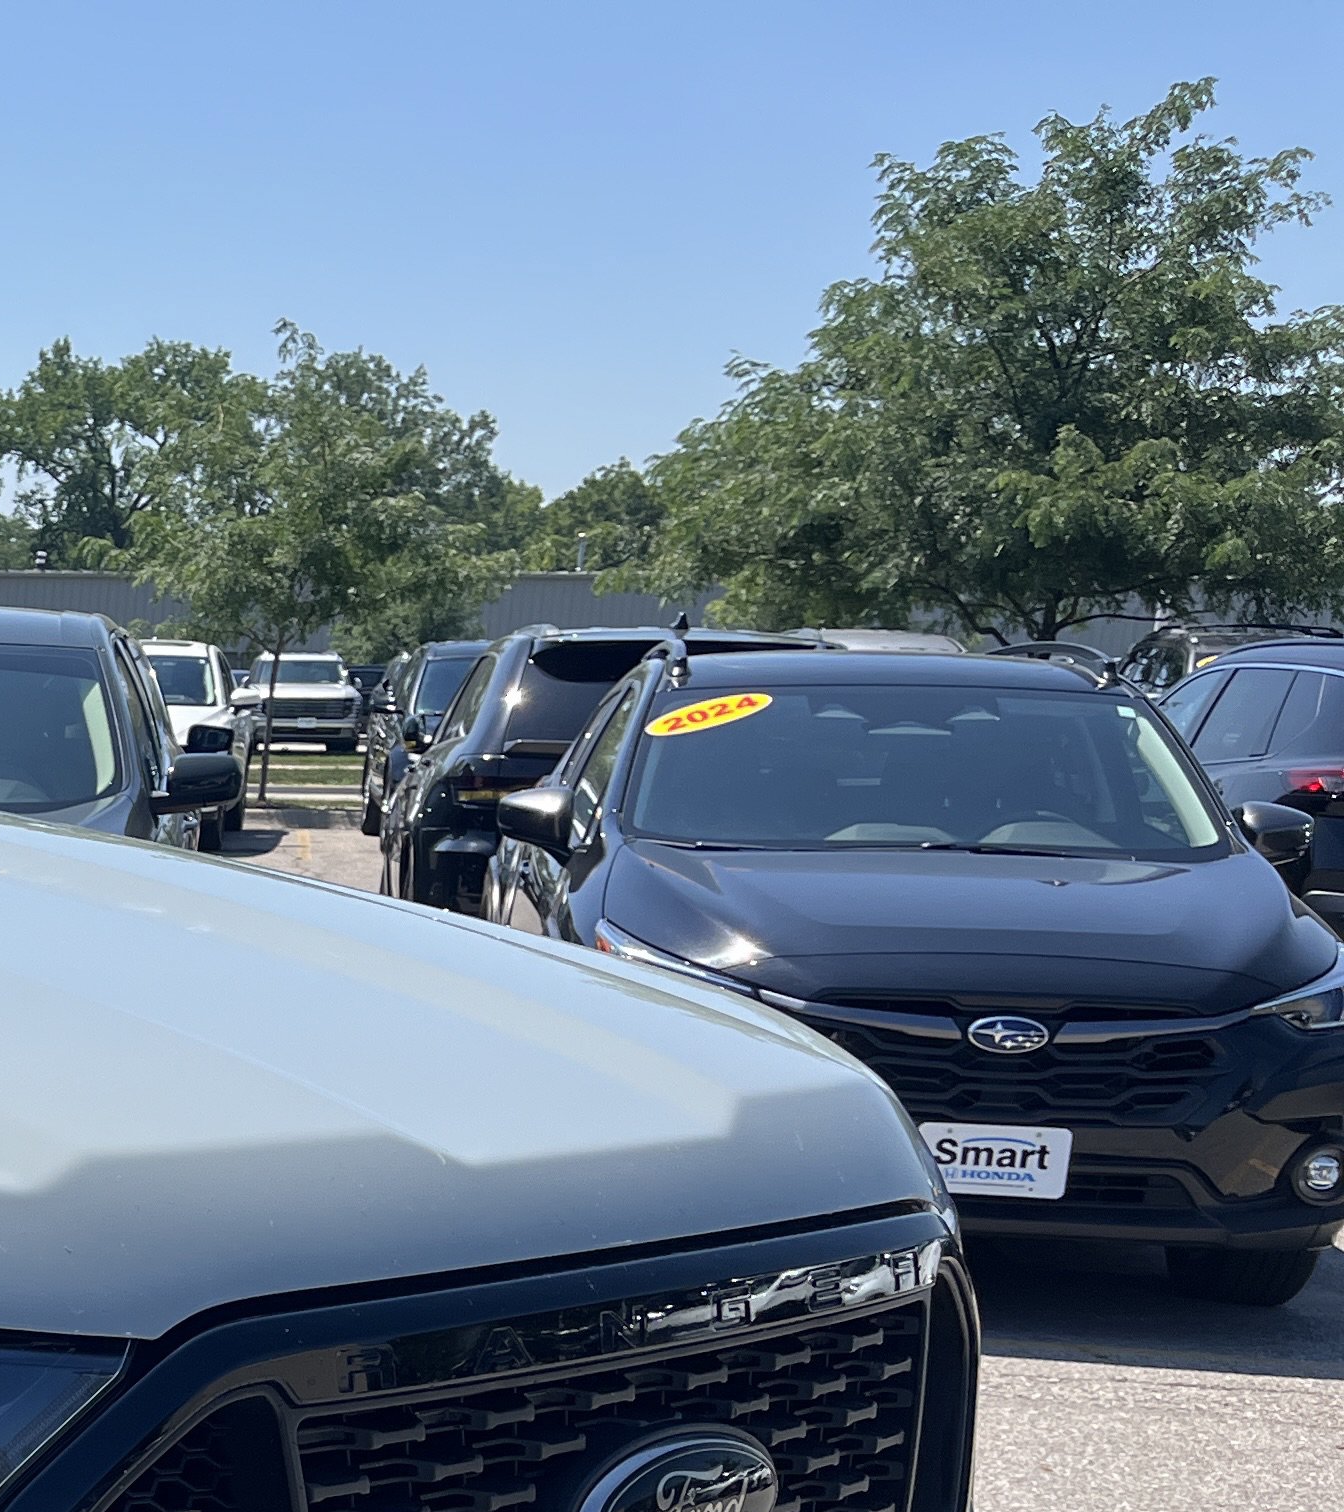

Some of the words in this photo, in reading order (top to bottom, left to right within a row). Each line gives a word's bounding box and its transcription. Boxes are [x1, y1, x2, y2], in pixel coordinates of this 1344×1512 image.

[663, 696, 759, 733] 2024
[934, 1138, 1050, 1170] Smart
[962, 1169, 1036, 1182] HONDA
[337, 1247, 924, 1393] RANGER
